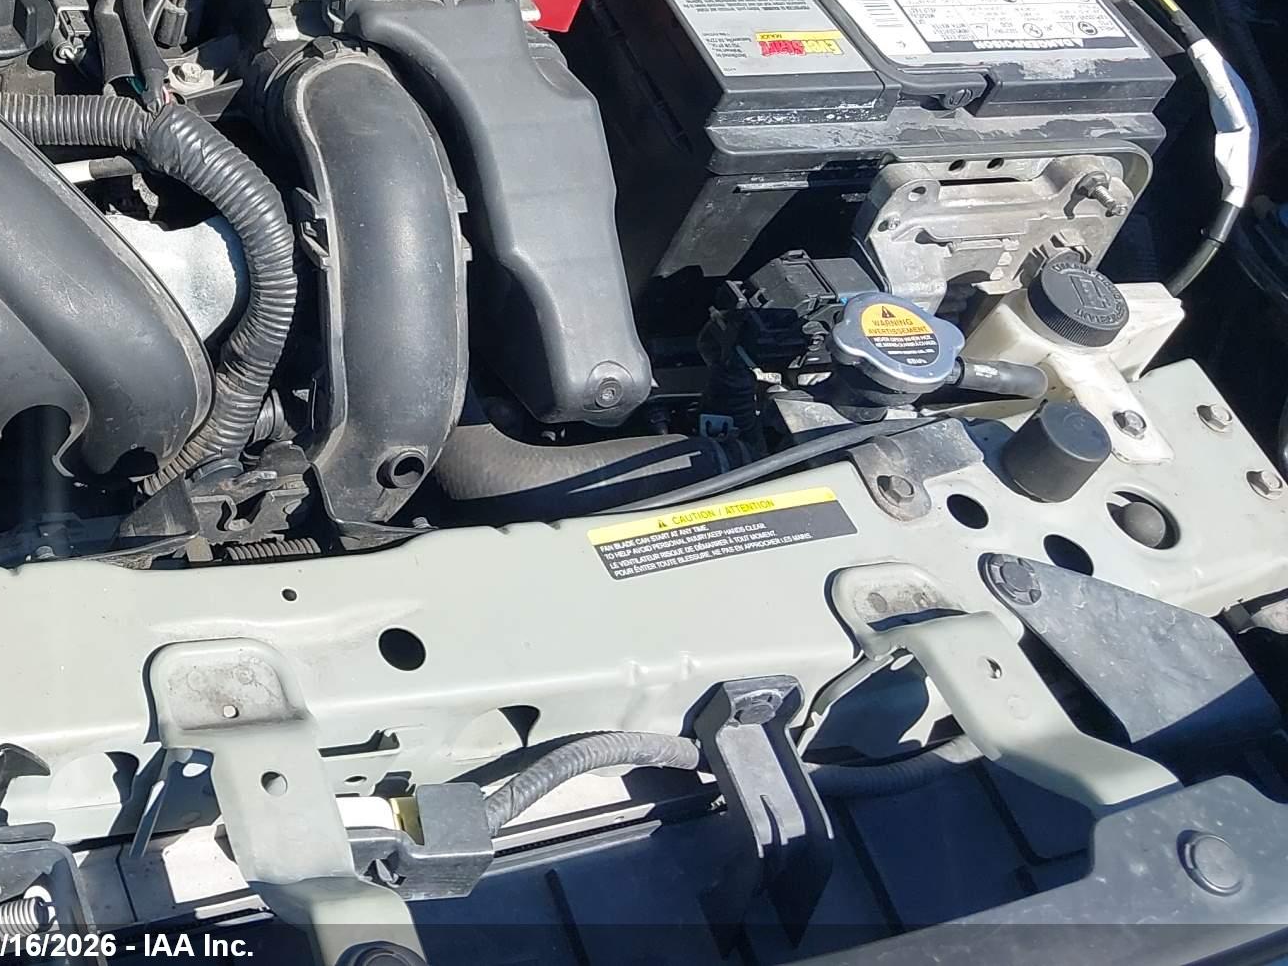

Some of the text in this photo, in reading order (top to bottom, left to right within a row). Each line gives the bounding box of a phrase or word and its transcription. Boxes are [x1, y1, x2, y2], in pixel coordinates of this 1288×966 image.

[871, 318, 914, 326] WARNING
[671, 510, 715, 525] CAUTION
[725, 499, 775, 514] ATTENTION
[614, 540, 635, 550] BLADE
[650, 532, 670, 542] START
[615, 549, 632, 557] HELP
[633, 545, 653, 554] AVOID
[614, 567, 635, 577] POUR
[657, 558, 678, 568] TOUTE
